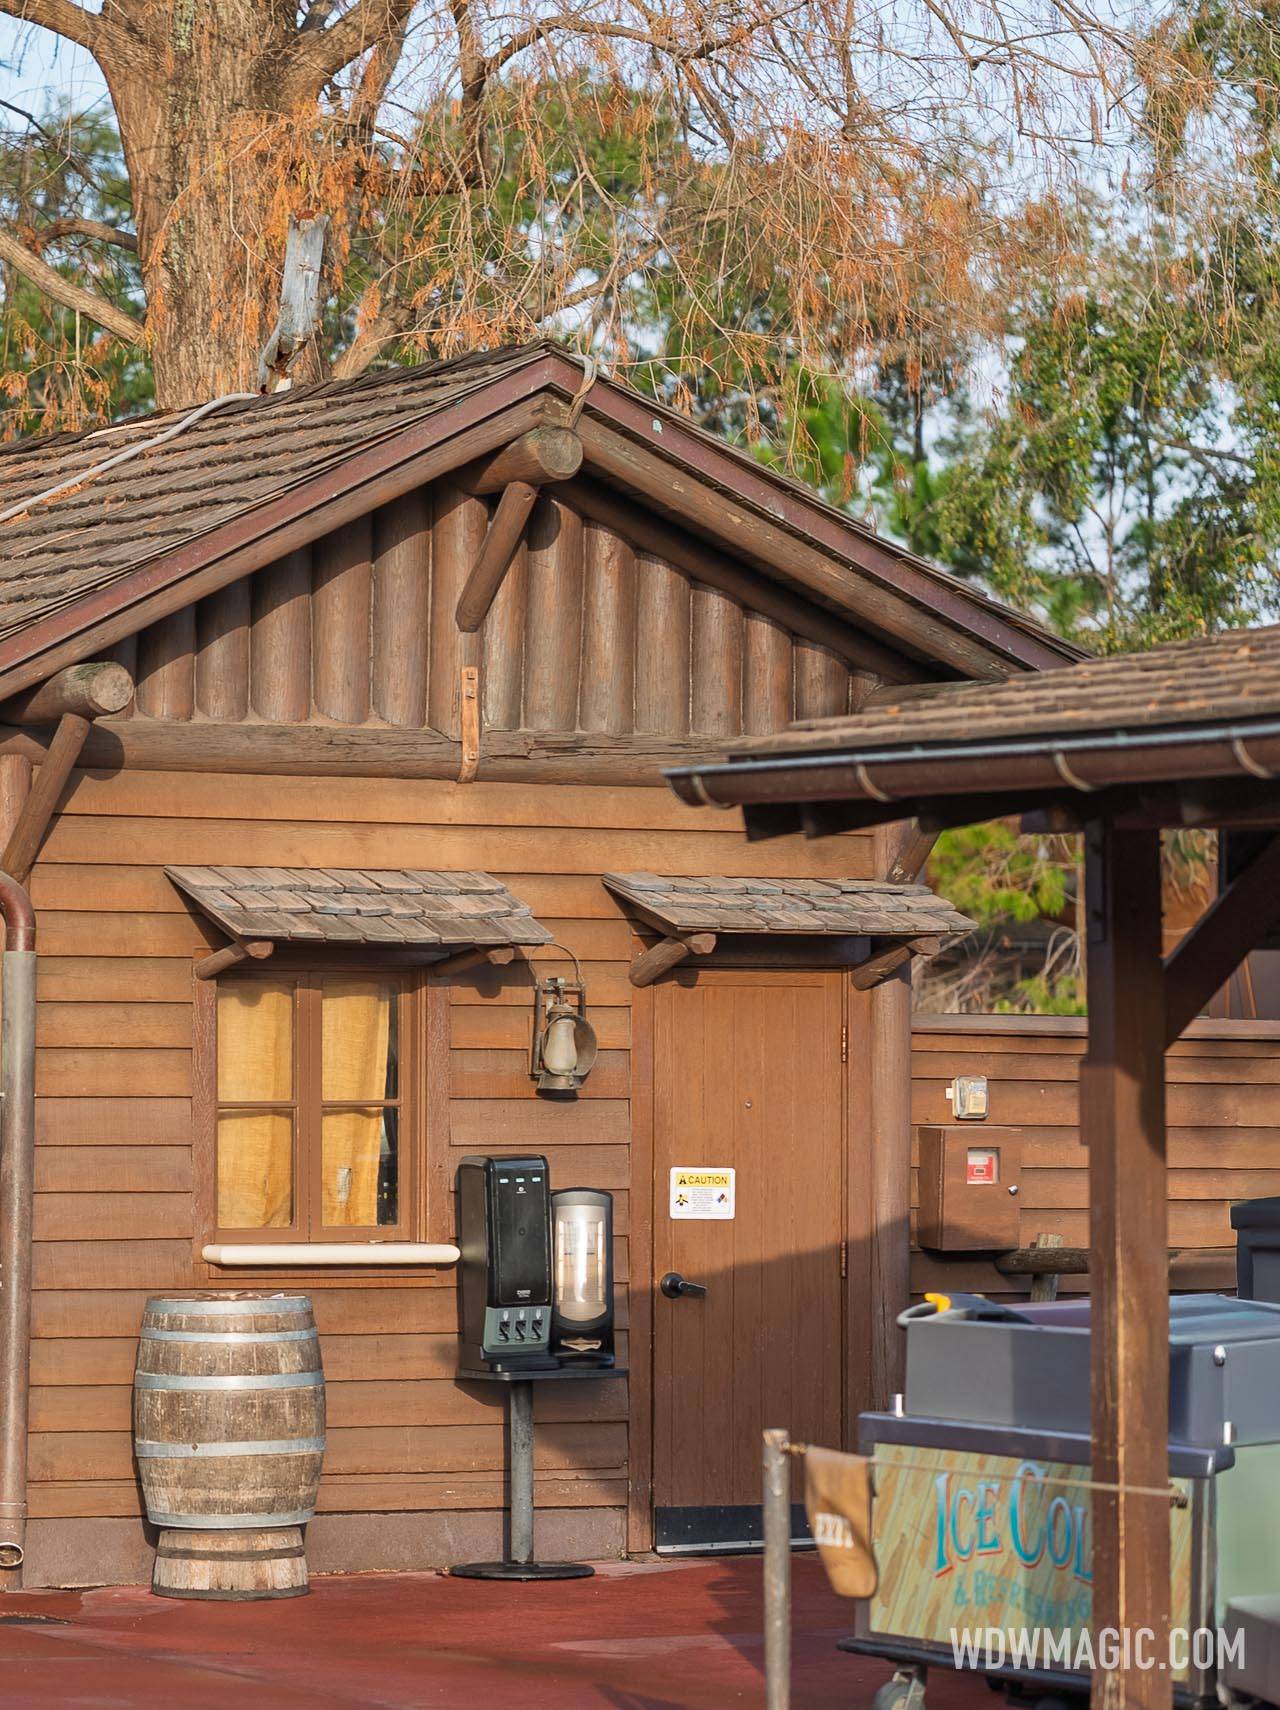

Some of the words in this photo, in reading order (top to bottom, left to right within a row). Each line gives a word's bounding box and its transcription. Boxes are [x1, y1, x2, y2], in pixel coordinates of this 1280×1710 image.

[688, 1176, 728, 1185] CAUTION
[935, 1472, 1002, 1576] ICE
[1009, 1460, 1094, 1584] COL
